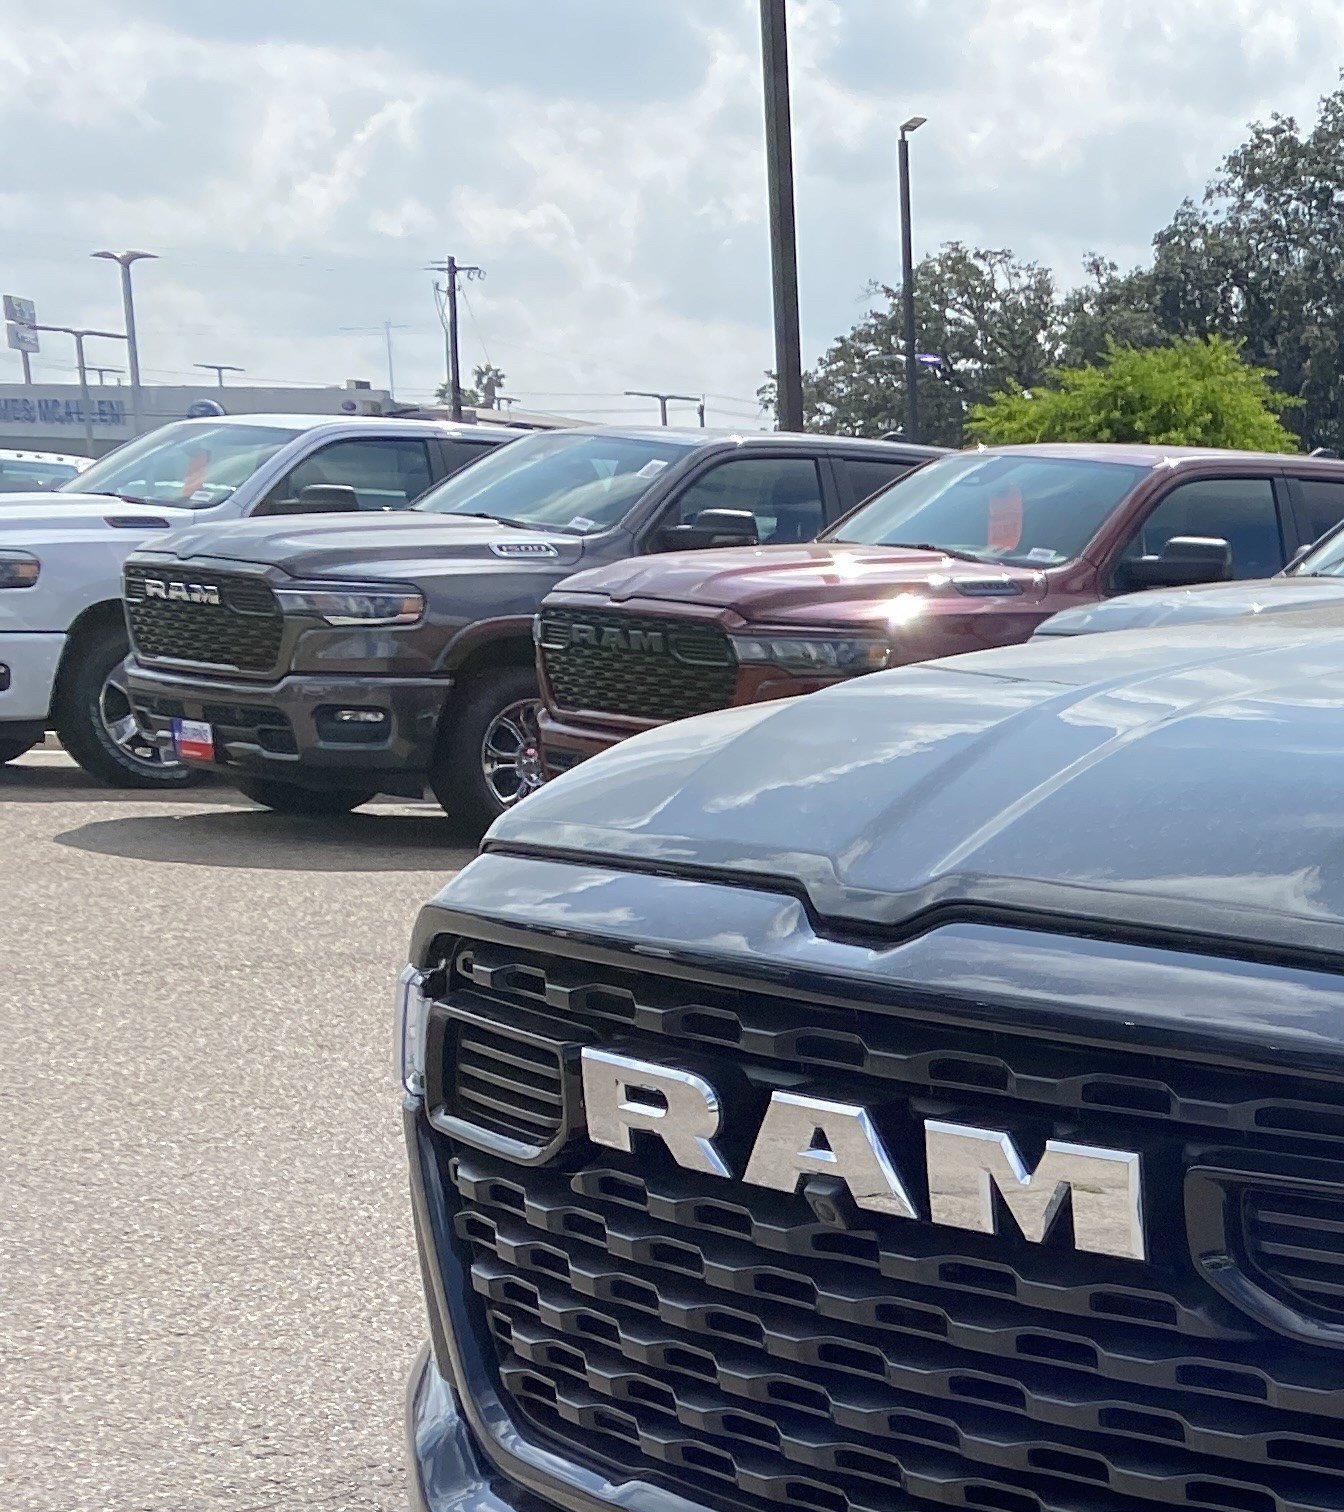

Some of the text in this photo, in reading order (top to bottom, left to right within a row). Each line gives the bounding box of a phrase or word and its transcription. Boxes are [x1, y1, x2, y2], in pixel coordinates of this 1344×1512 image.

[145, 578, 220, 605] RAM
[571, 623, 663, 653] RAM
[581, 1046, 1147, 1262] RAM
